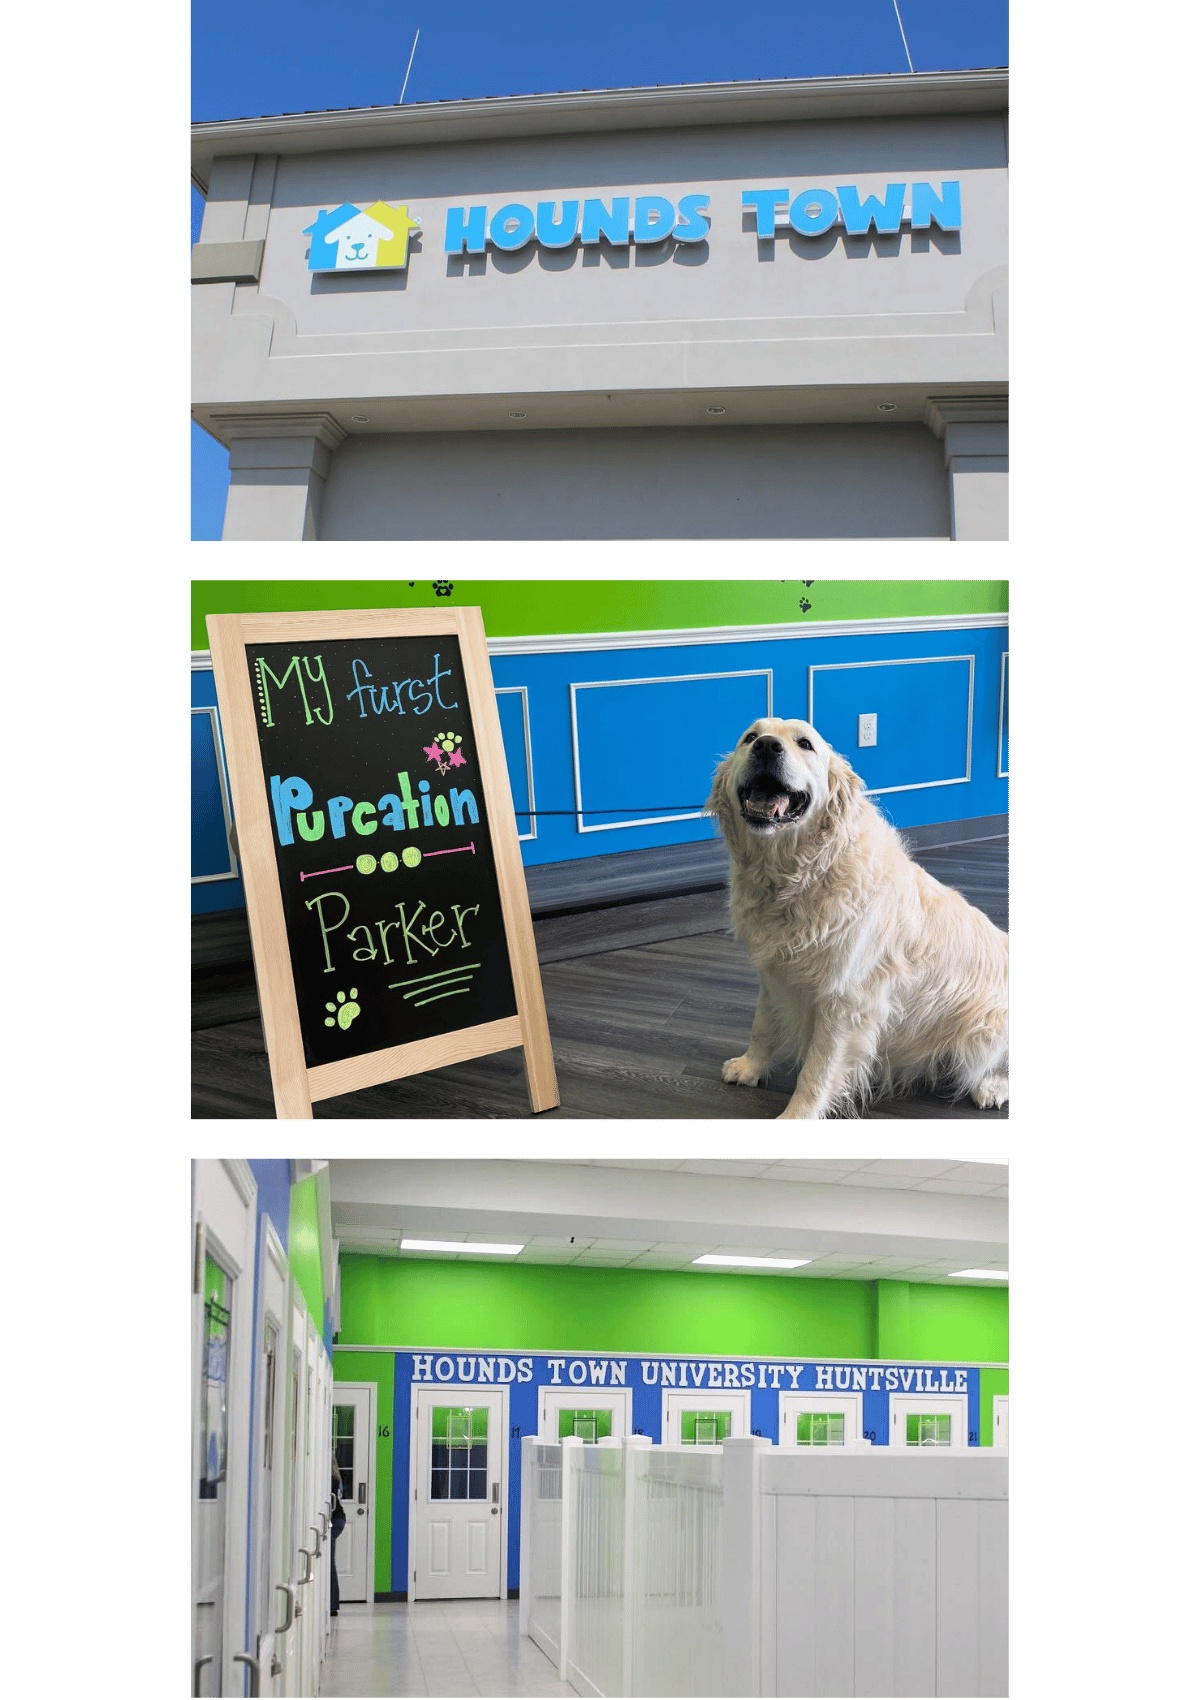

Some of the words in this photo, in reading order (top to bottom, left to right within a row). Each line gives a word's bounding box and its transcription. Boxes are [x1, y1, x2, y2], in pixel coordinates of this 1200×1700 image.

[445, 196, 710, 255] HOUNDS
[742, 181, 962, 239] TOWN
[255, 655, 334, 727] My
[346, 653, 458, 717] furst
[412, 1355, 533, 1383] HOUNDS
[547, 1359, 627, 1385] TOWN
[641, 1361, 804, 1388] UNIVERSITY
[815, 1367, 968, 1392] HUNTSVILLE
[378, 1424, 390, 1437] 16
[863, 1430, 876, 1441] 20
[968, 1431, 978, 1442] 21
